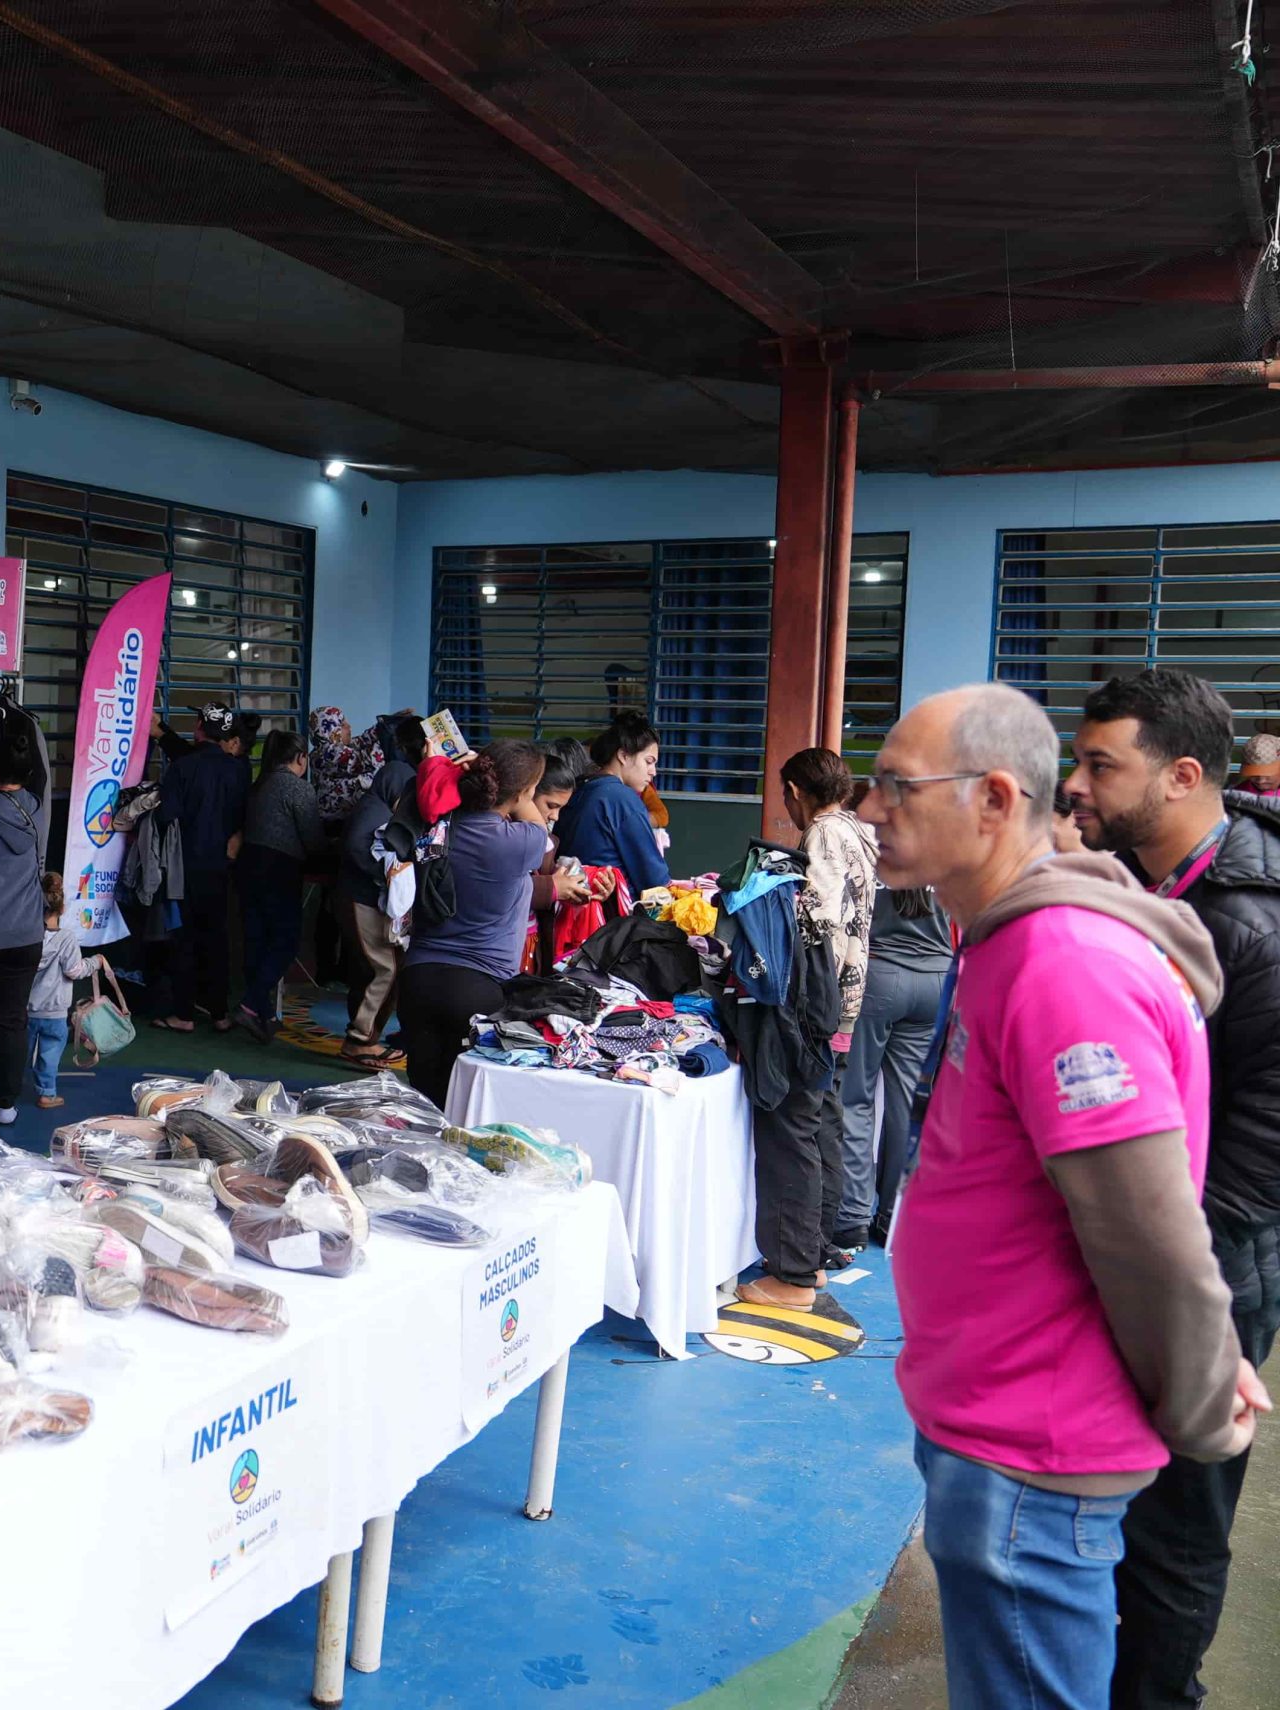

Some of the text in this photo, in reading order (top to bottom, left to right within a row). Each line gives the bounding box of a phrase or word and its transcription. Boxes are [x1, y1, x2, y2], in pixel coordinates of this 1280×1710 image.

[89, 694, 115, 776] Varal
[111, 633, 139, 776] Solidário
[95, 871, 118, 882] FUND
[479, 1258, 540, 1311] MASCULINOS
[485, 1236, 537, 1281] CALÇADOS
[192, 1378, 297, 1463] INFANTIL
